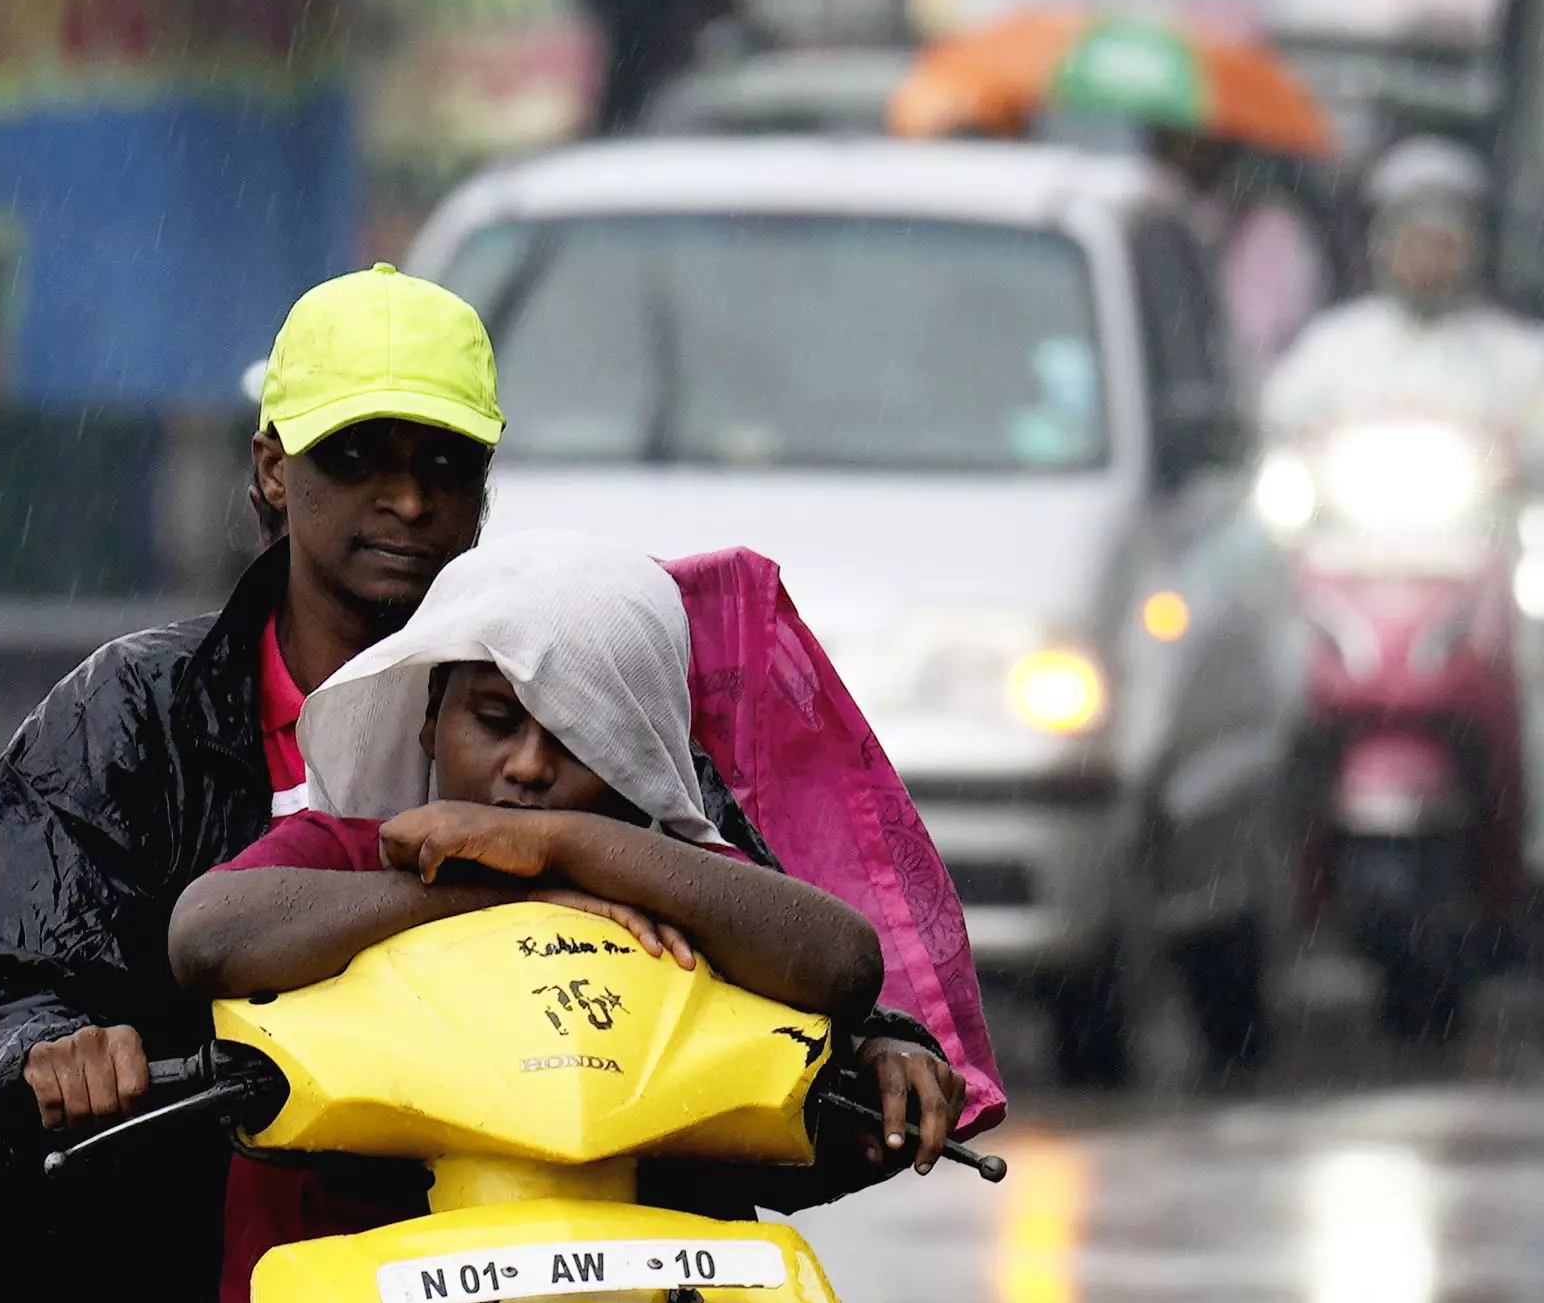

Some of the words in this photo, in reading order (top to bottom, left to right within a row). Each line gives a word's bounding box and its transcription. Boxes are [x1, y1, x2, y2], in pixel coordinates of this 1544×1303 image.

[520, 1054, 624, 1074] HONDA
[551, 1252, 604, 1284] AW
[674, 1248, 716, 1280] 10
